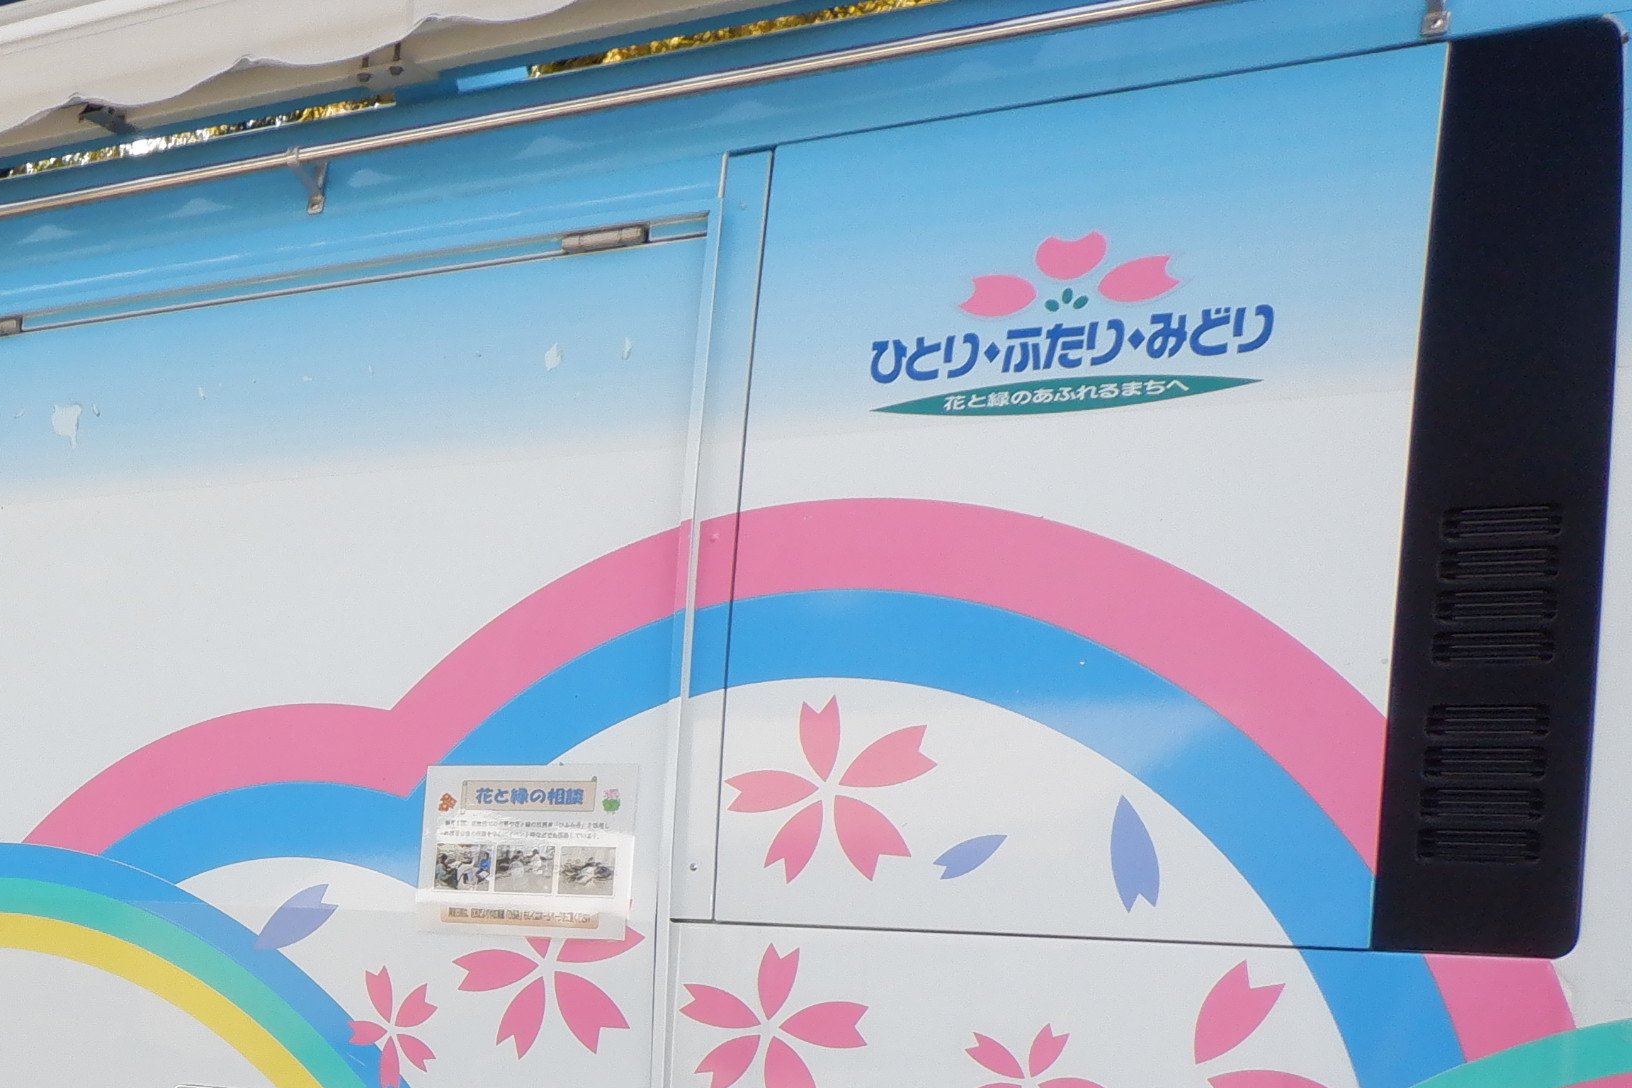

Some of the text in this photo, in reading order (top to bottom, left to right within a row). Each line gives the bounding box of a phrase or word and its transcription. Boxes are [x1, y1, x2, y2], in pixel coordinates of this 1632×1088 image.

[943, 379, 1190, 412] 花と緑のあふれるまちへ
[475, 787, 585, 806] 花と緑の相談
